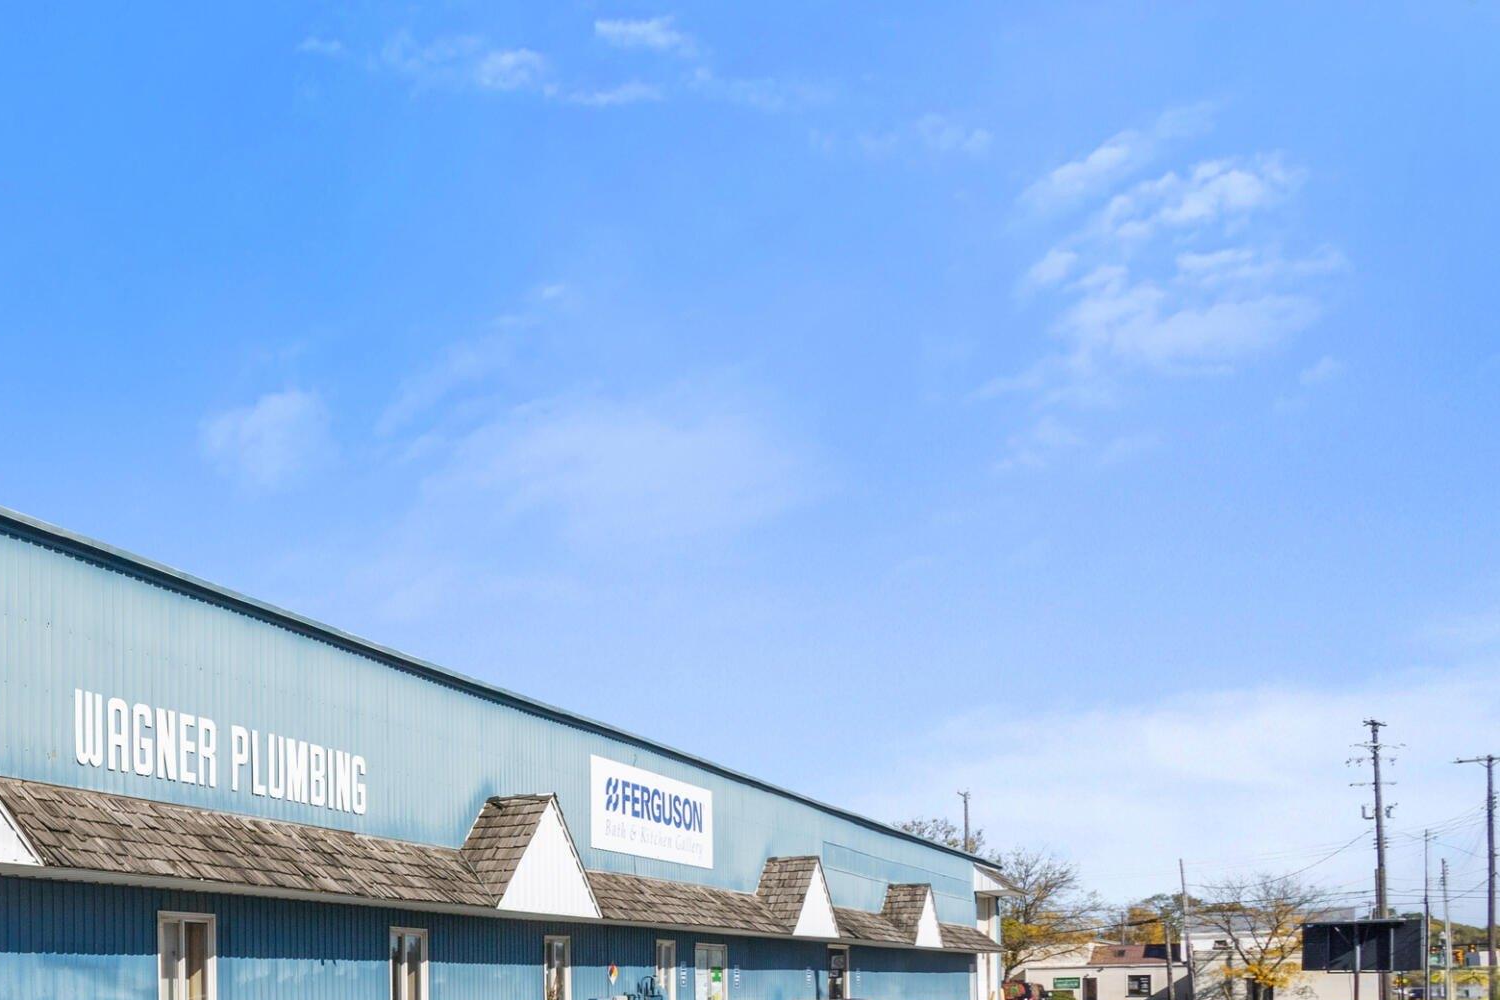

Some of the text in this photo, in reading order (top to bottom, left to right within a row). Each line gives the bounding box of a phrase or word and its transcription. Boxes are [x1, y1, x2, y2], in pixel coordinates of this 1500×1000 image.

[74, 688, 367, 816] WAGNER PLUMBING
[621, 780, 703, 833] FERGUSON
